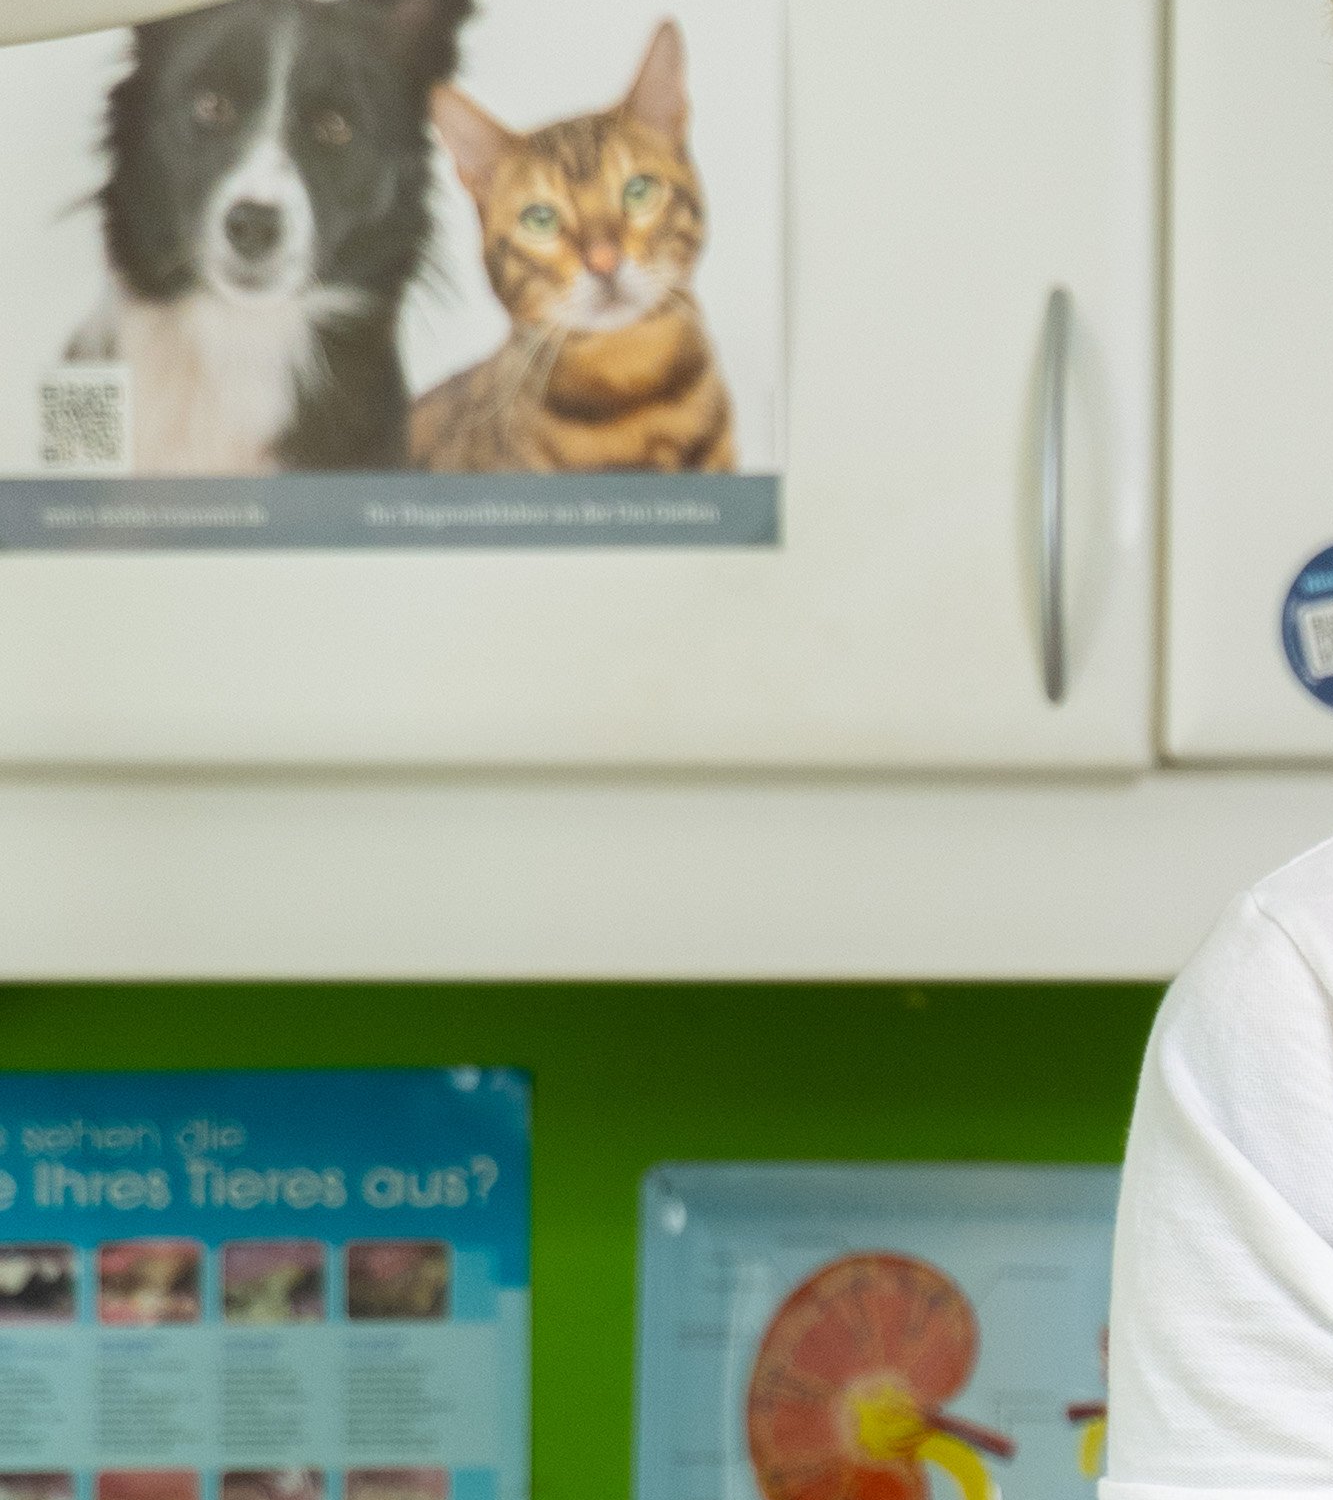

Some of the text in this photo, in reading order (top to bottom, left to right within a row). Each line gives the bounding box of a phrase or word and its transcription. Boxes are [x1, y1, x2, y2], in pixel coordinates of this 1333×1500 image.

[21, 1117, 160, 1154] sehen
[175, 1117, 247, 1156] die
[33, 1160, 169, 1211] Ihres
[184, 1157, 347, 1211] Tieres
[362, 1154, 499, 1210] aus?
